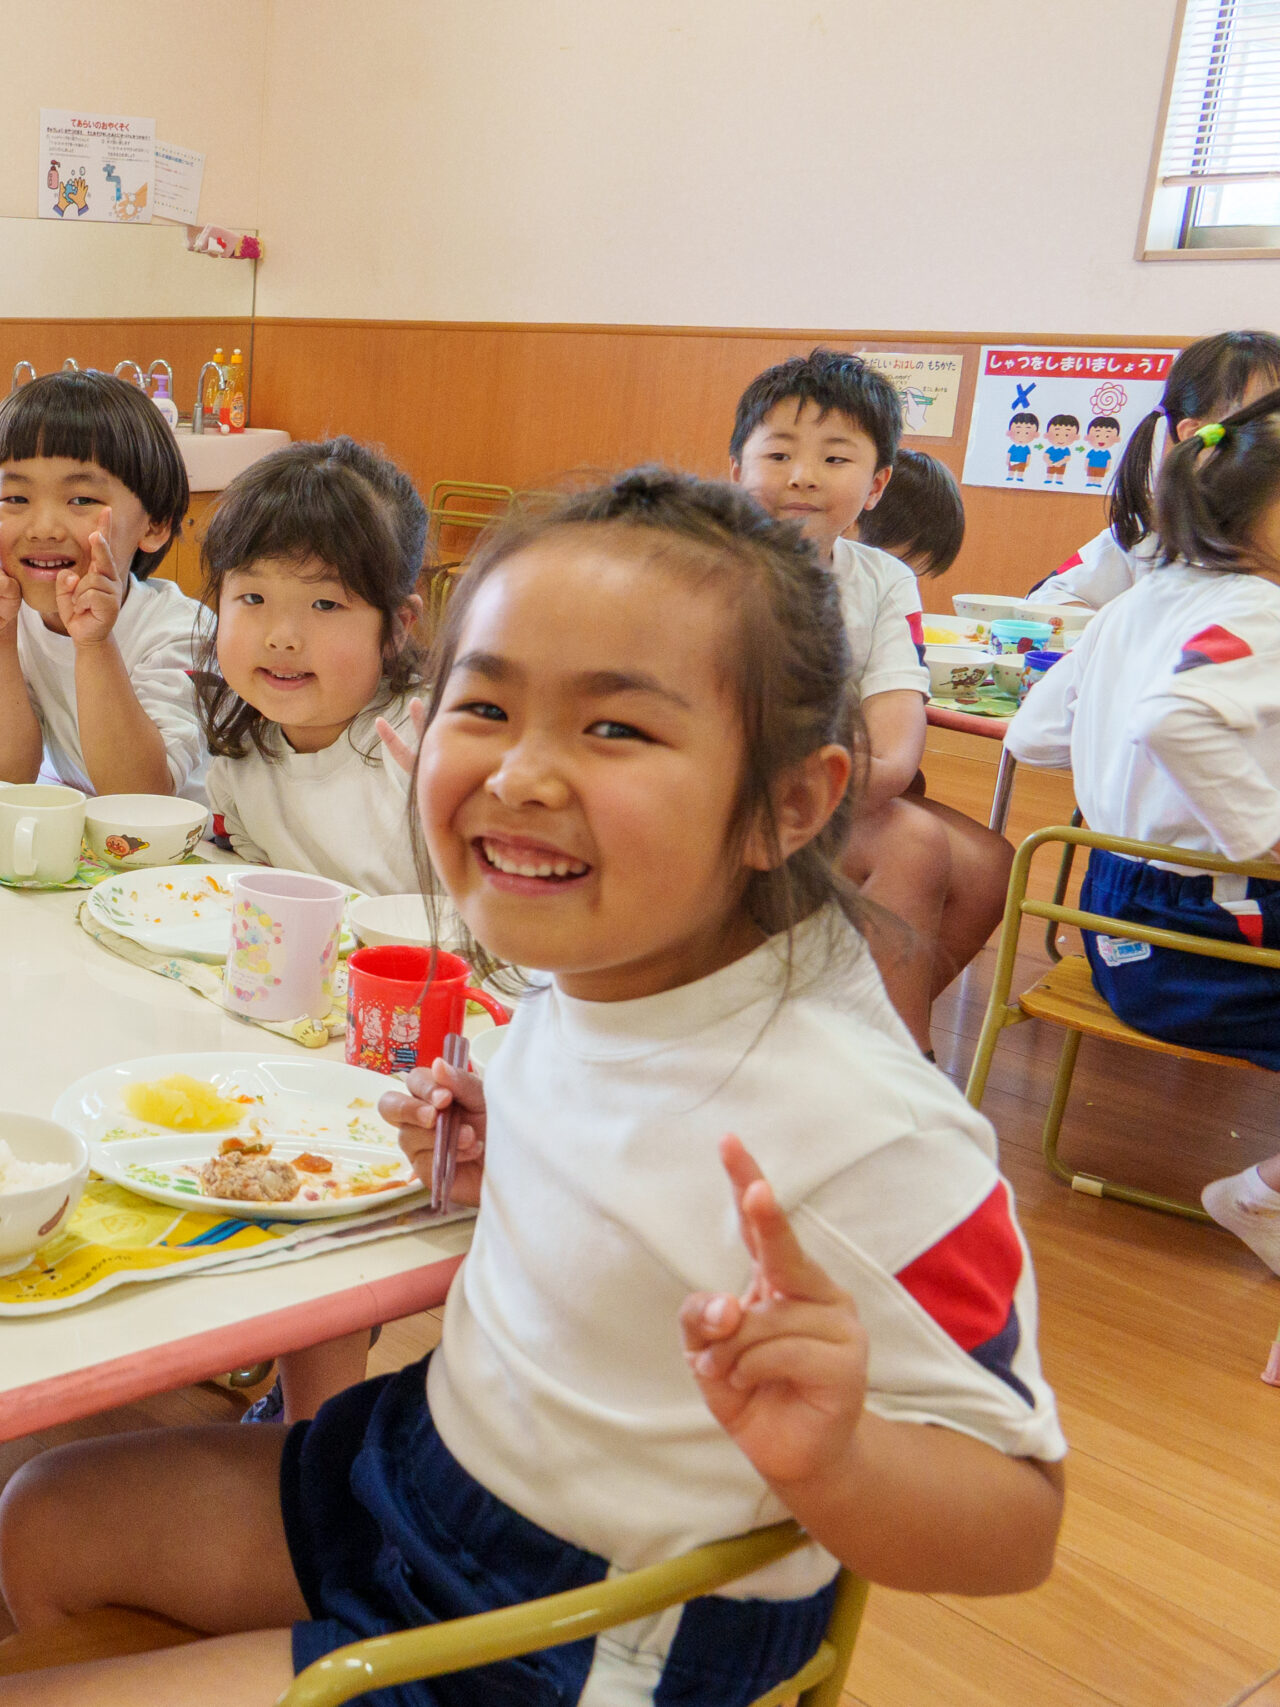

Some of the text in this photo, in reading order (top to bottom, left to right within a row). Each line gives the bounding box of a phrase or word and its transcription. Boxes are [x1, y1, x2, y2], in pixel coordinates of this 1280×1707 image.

[71, 119, 130, 131] てあらいのおやくそく
[989, 354, 1167, 374] しゃつをしまいましょう！
